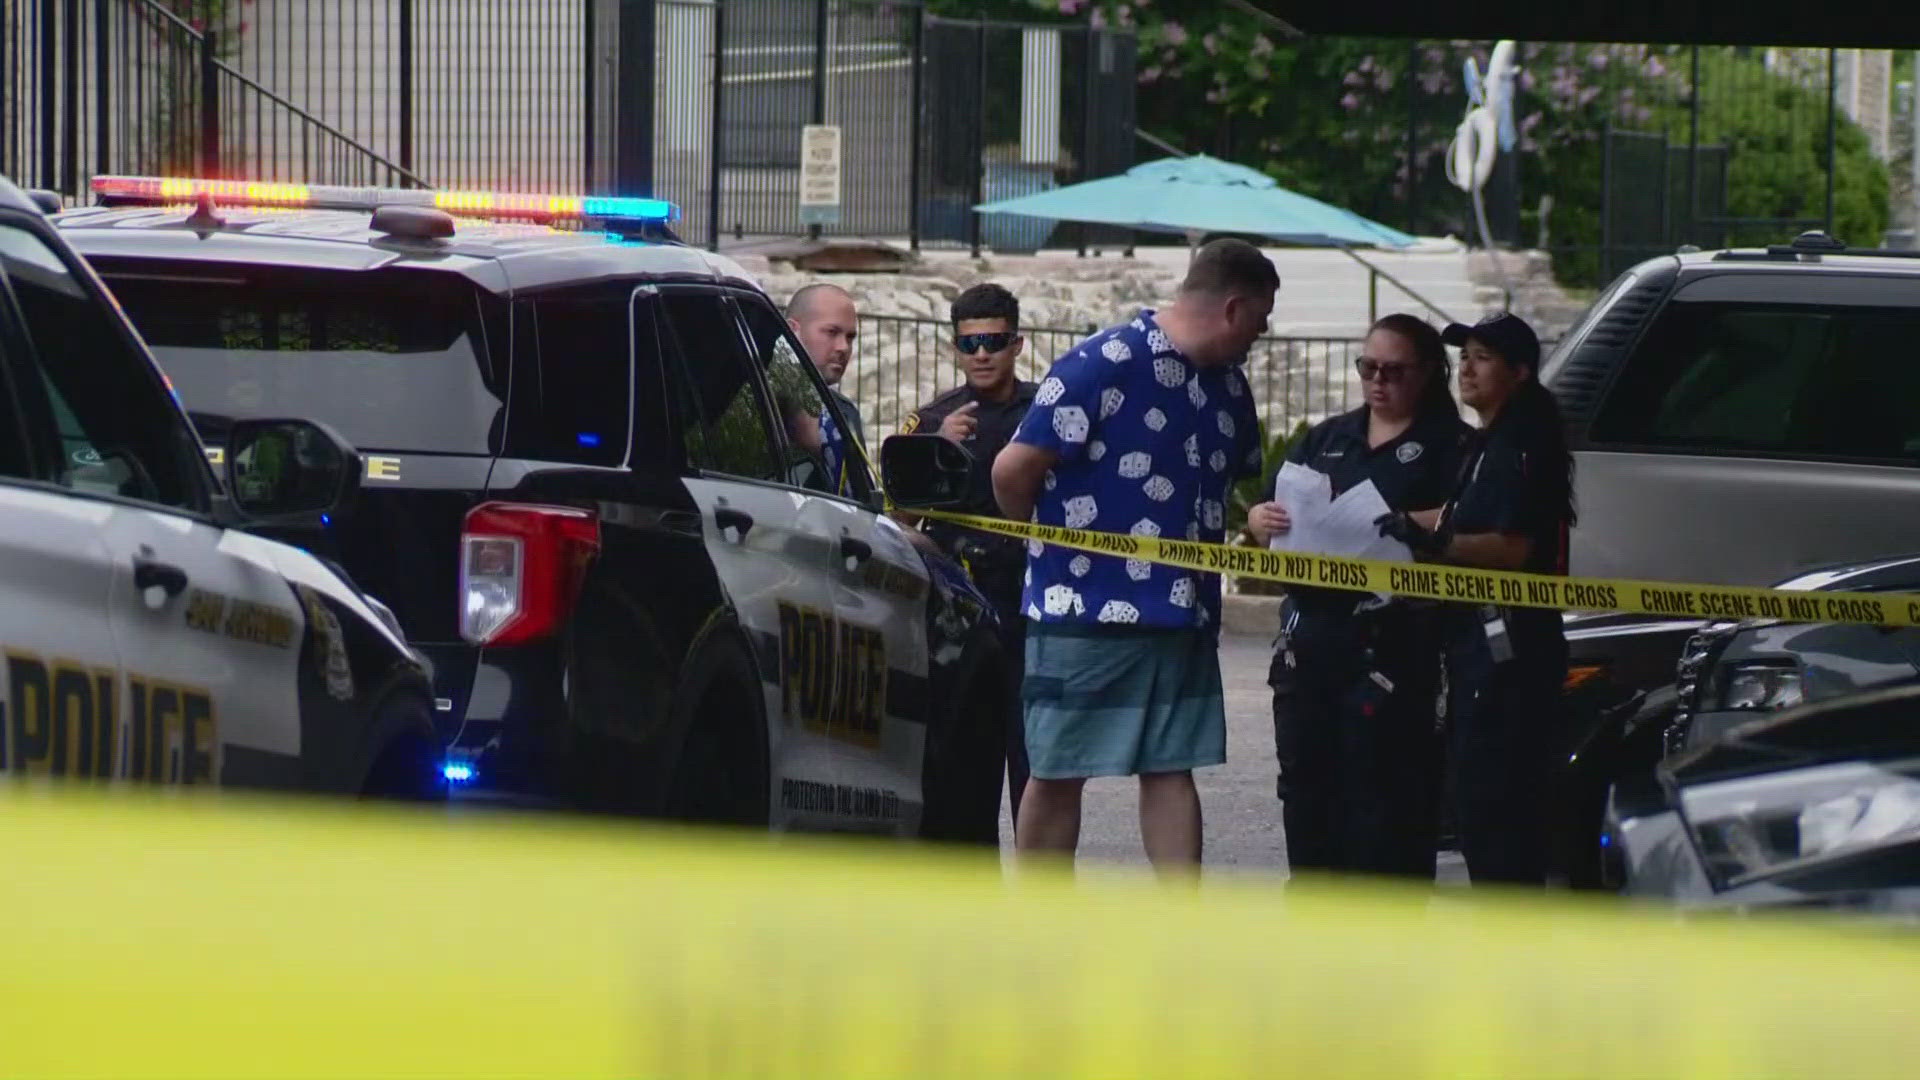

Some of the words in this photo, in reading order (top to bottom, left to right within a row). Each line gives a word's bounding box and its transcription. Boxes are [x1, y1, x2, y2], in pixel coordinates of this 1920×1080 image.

[1158, 540, 1204, 564] CRIME
[1209, 547, 1256, 572] SCENE
[1260, 556, 1281, 575] DO
[1285, 558, 1313, 580] NOT
[1319, 561, 1368, 587] CROSS
[1390, 567, 1440, 595] CRIME
[1445, 572, 1496, 600] SCENE
[1500, 579, 1522, 602] DO
[1529, 582, 1558, 605] NOT
[1564, 584, 1618, 609] CROSS
[1640, 589, 1696, 614] CRIME
[1700, 592, 1756, 617] SCENE
[1760, 596, 1782, 618] DO
[1787, 598, 1821, 620] NOT
[1826, 599, 1885, 623] CROSS
[779, 602, 884, 742] POLICE
